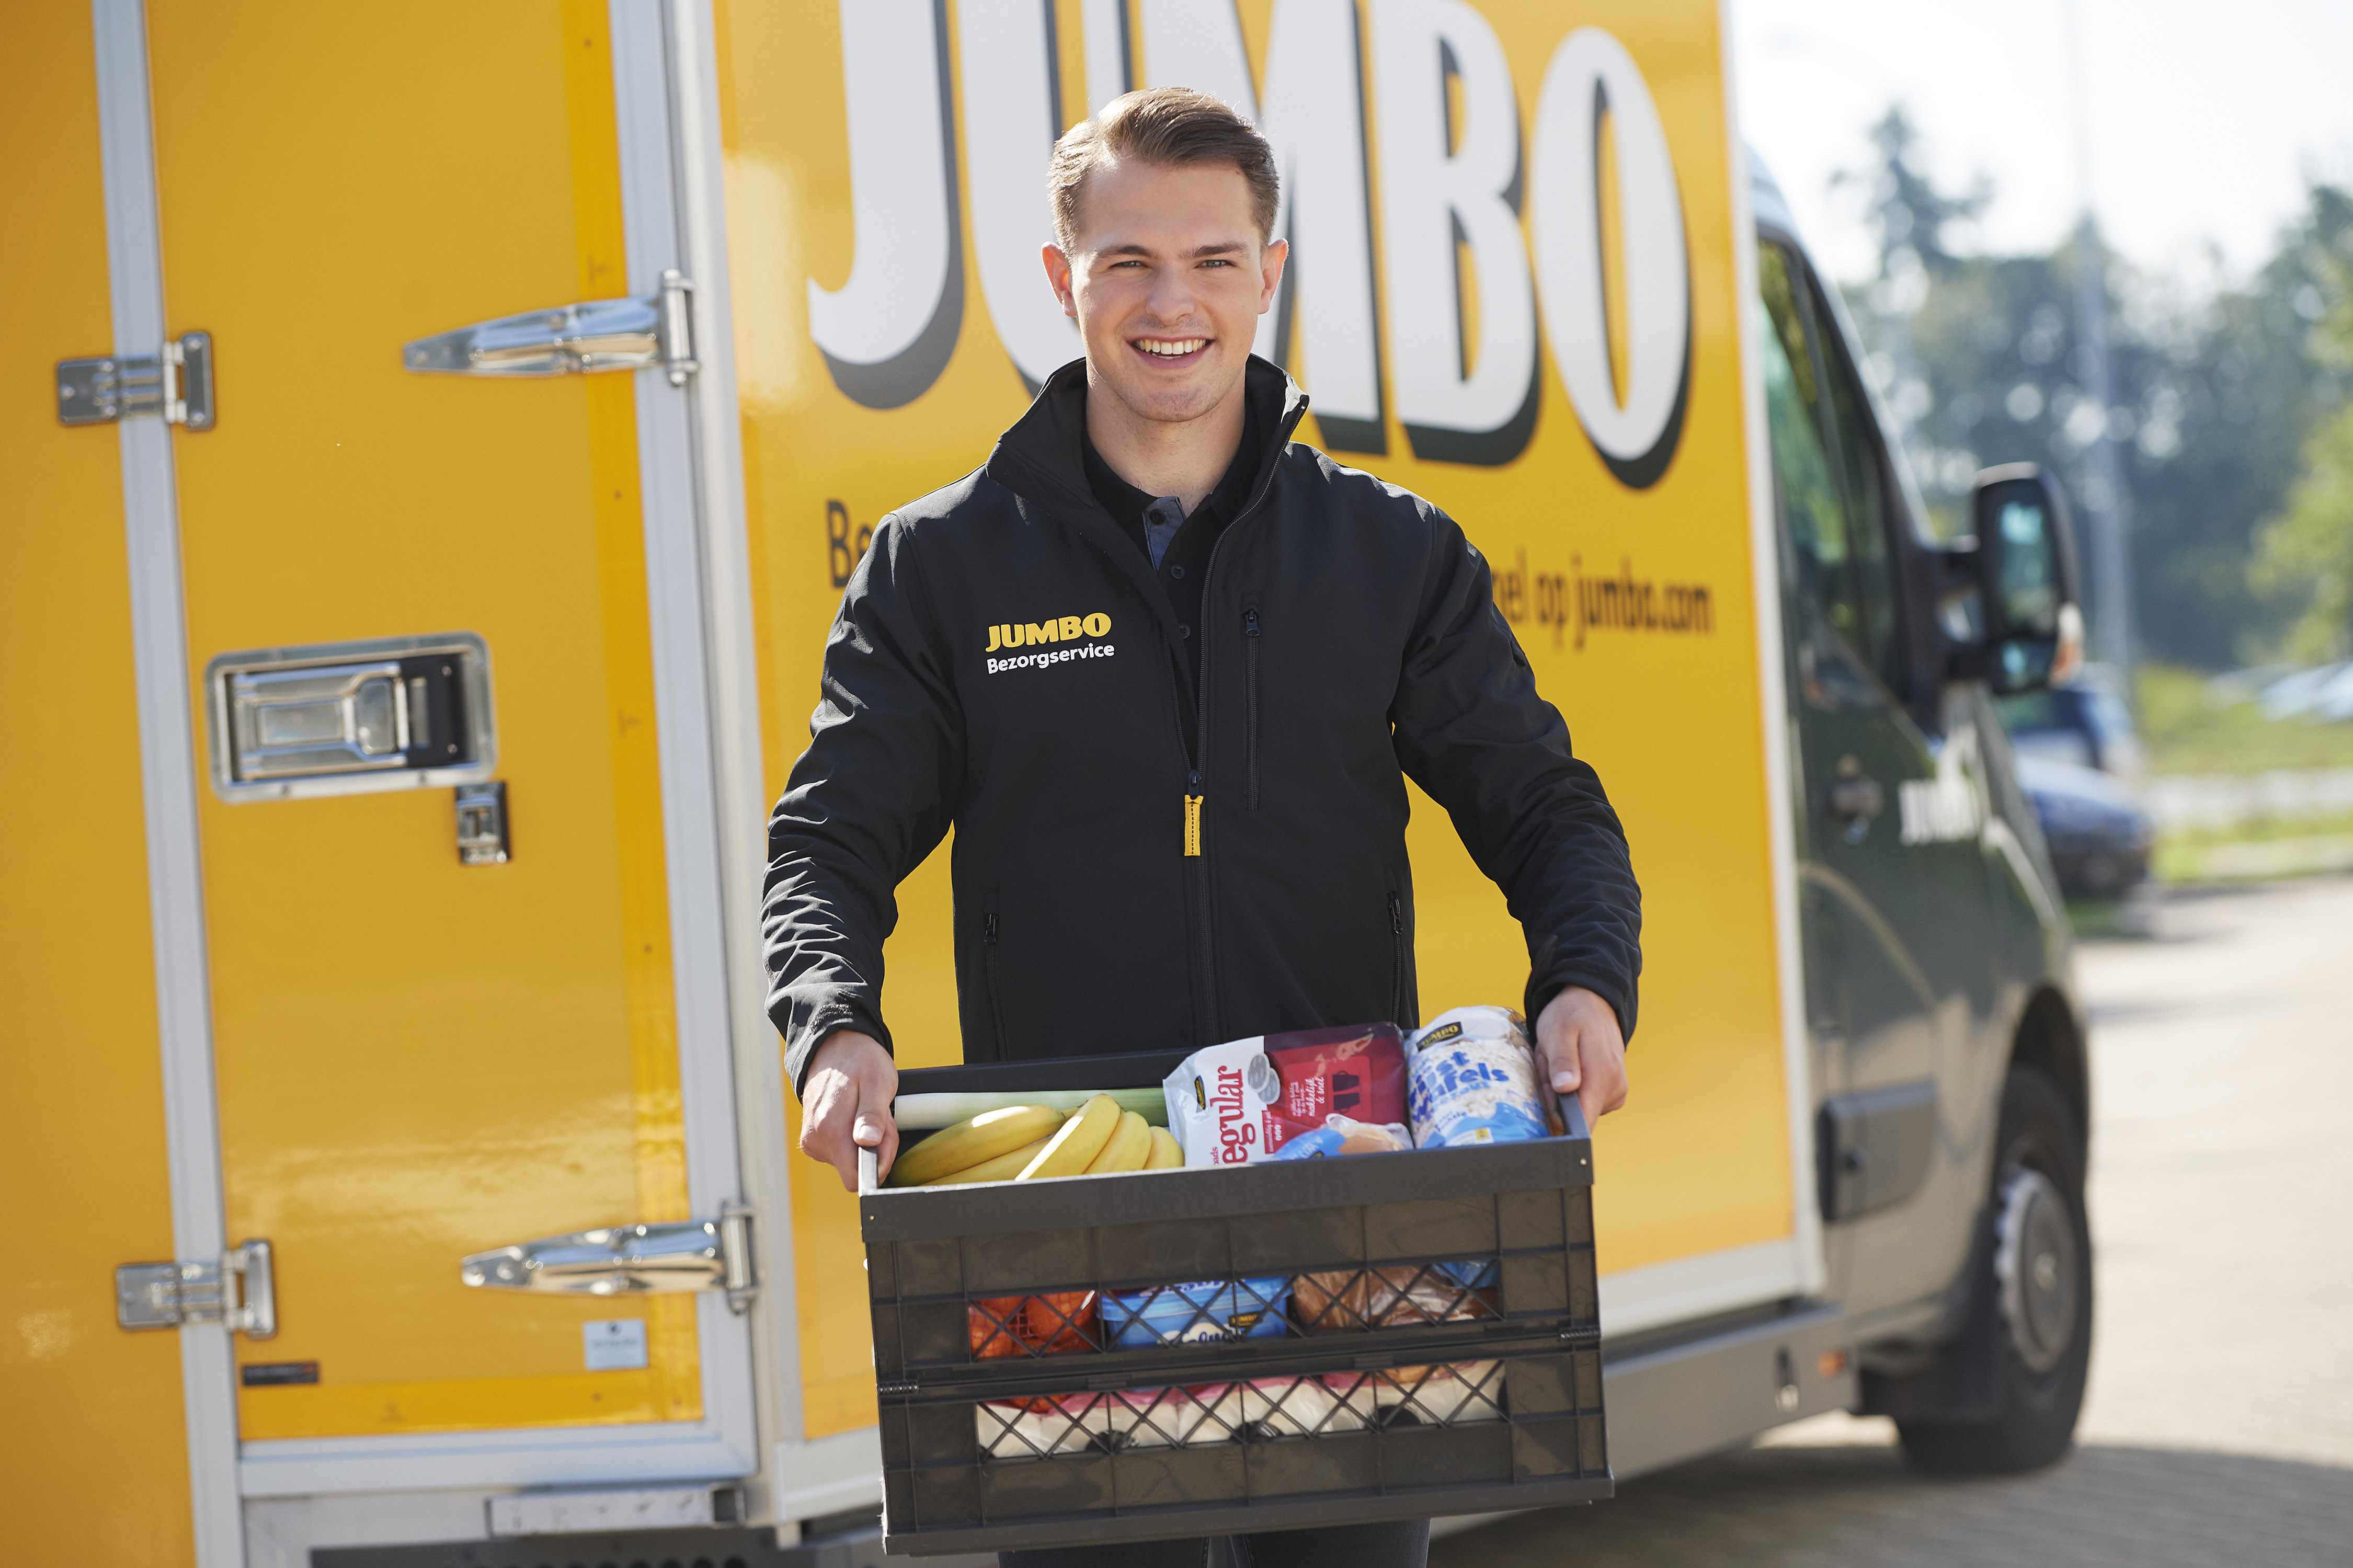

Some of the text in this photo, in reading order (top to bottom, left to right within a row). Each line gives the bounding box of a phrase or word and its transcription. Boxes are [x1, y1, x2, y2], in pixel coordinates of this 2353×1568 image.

[986, 613, 1112, 652] JUMBO
[987, 643, 1115, 674] Bezorgservice
[1305, 1077, 1318, 1117] makkelijk
[1314, 1077, 1325, 1094] snel
[1209, 1065, 1257, 1164] egular
